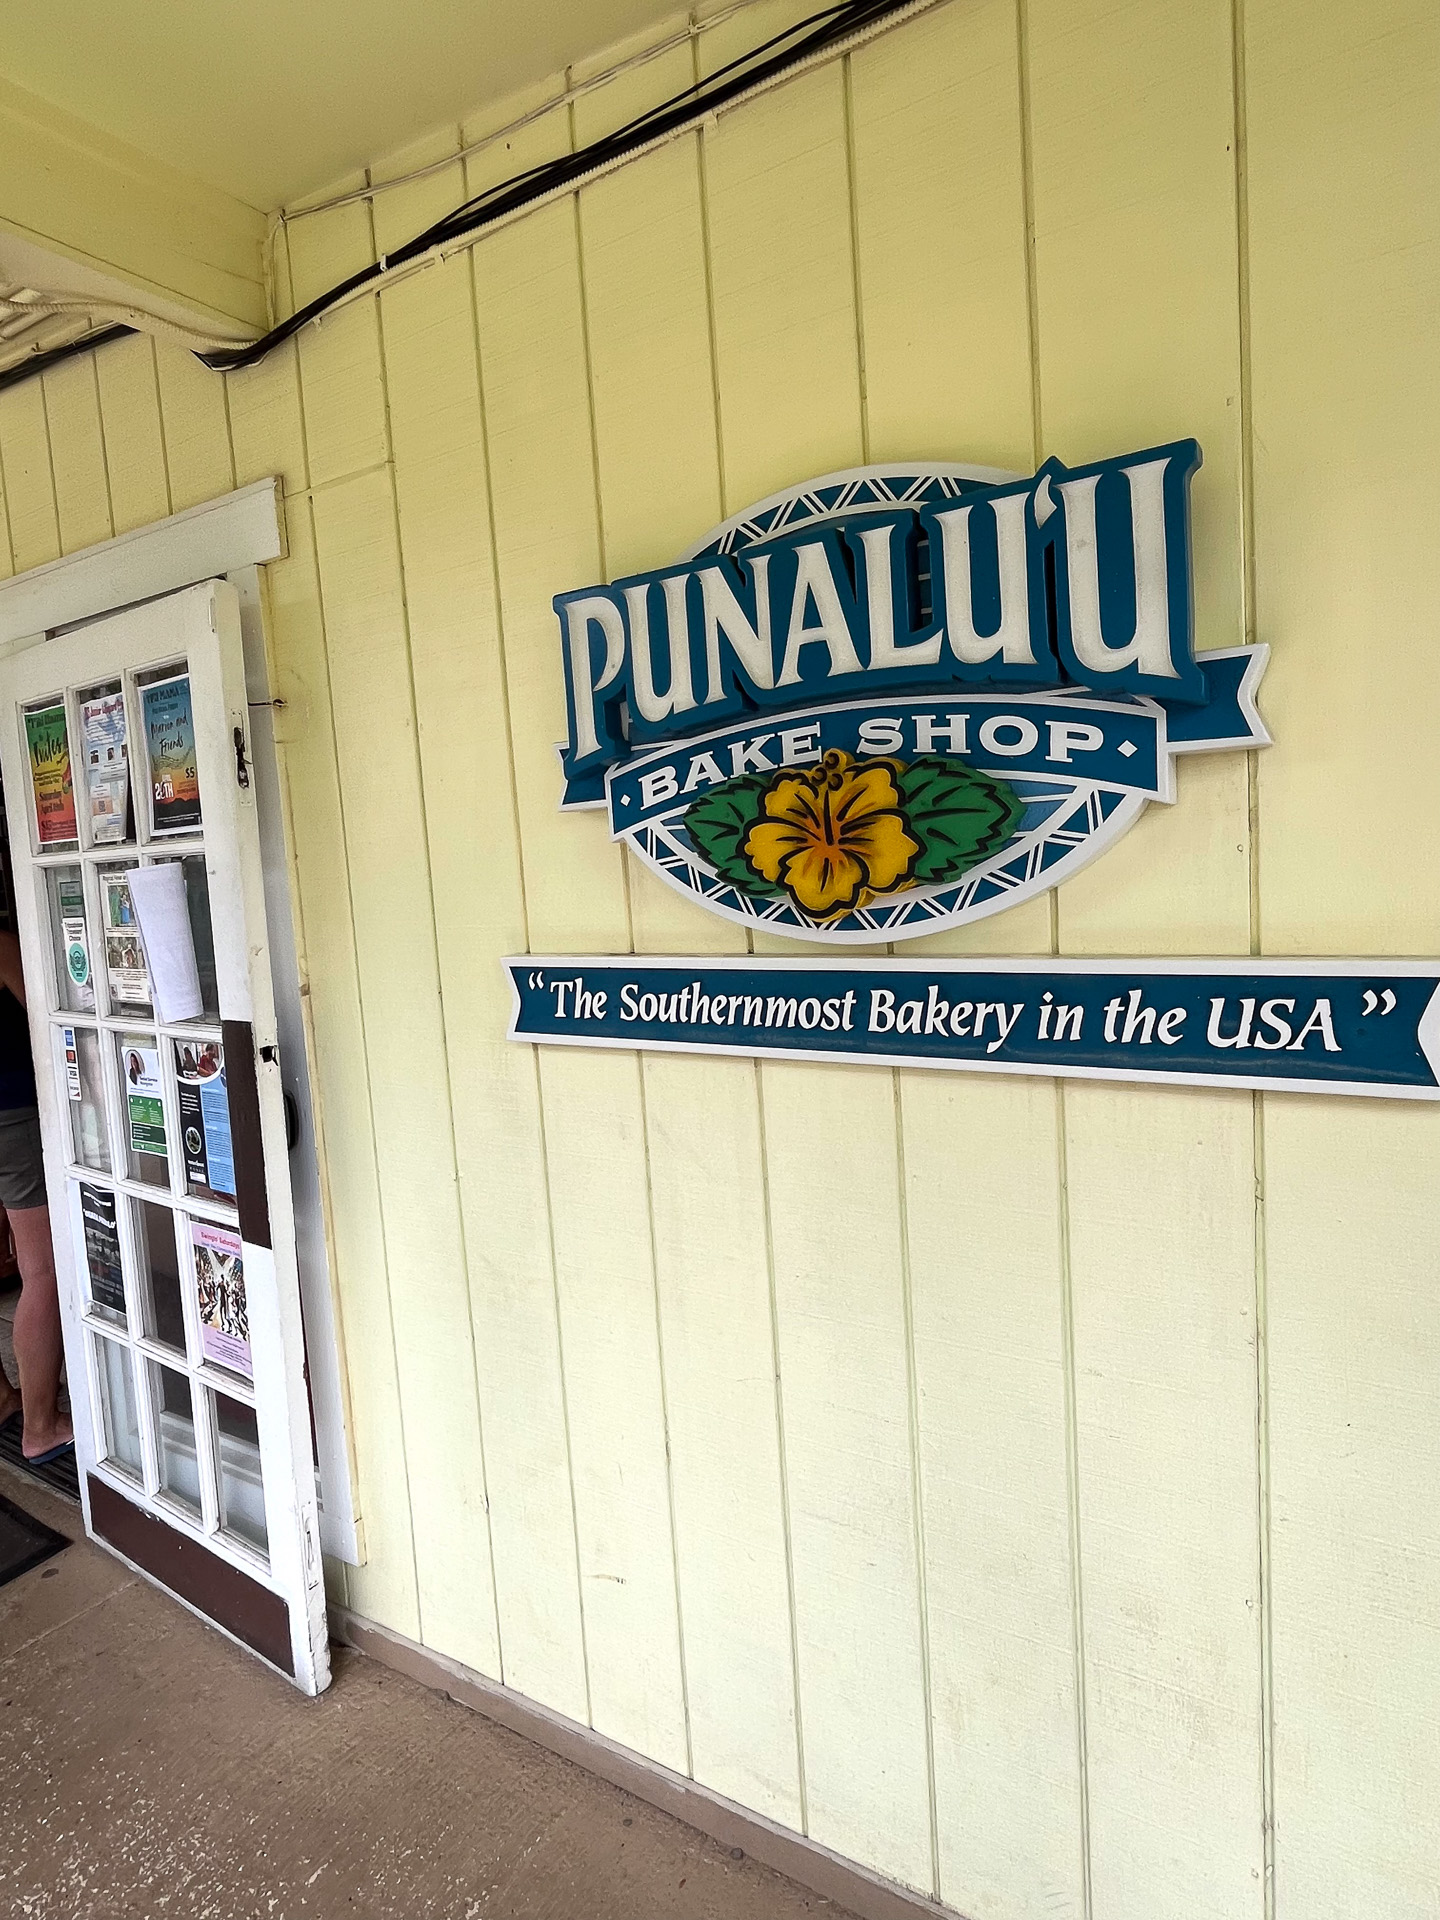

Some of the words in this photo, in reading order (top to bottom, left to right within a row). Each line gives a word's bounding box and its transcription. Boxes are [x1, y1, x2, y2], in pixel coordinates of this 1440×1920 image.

[185, 766, 195, 779] $5
[640, 722, 823, 810] BAKE
[856, 714, 1104, 763] SHOP
[619, 981, 857, 1032] Southernmost
[867, 984, 1025, 1054] Bakery
[1036, 991, 1086, 1042] in
[1102, 989, 1188, 1045] the
